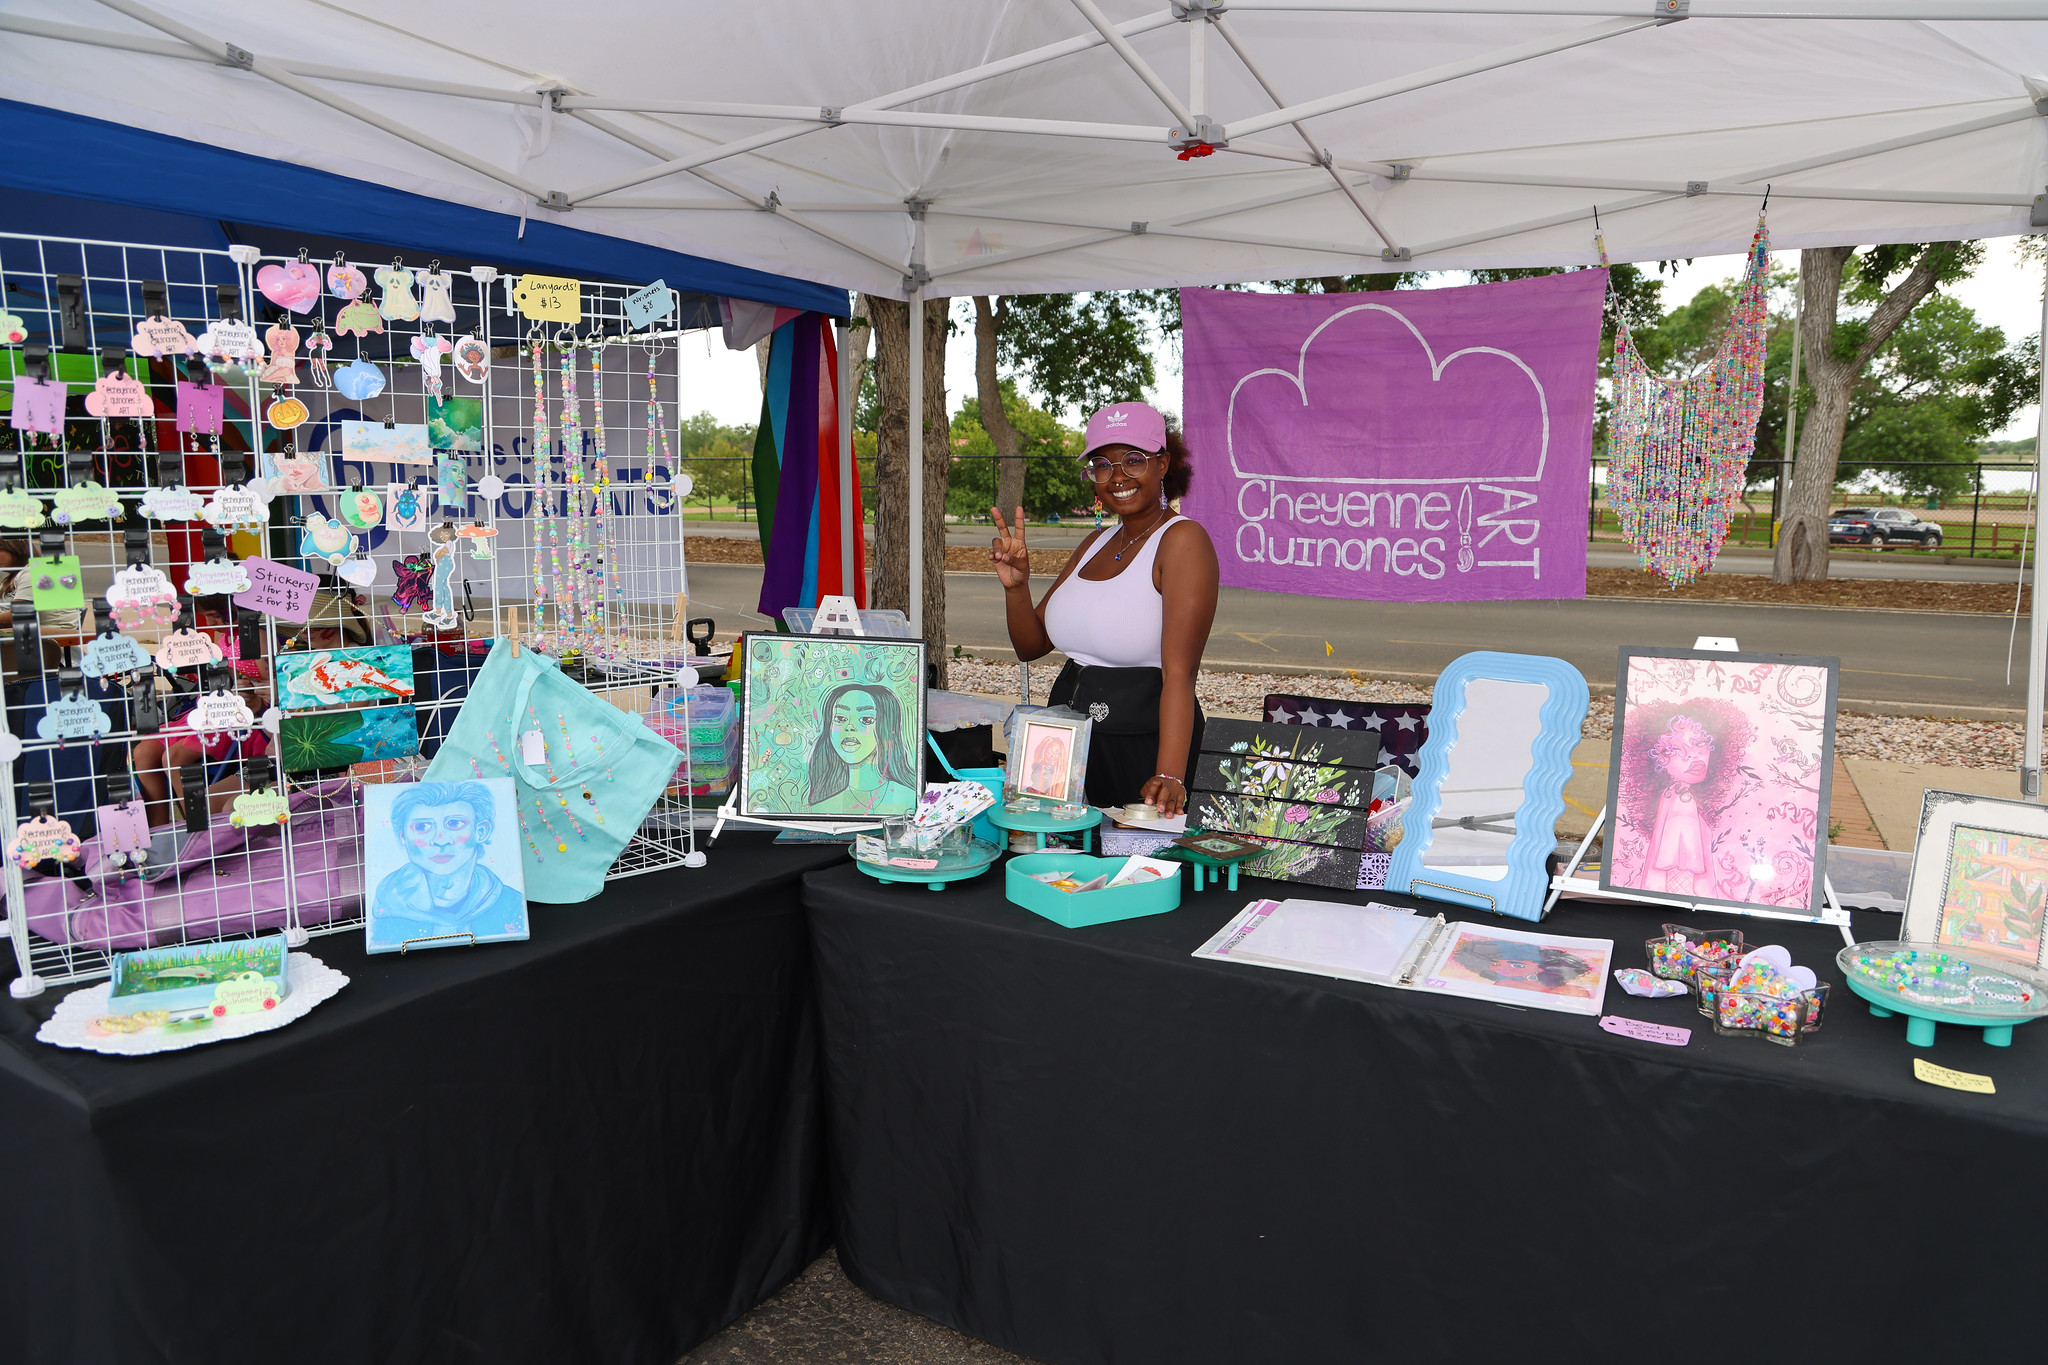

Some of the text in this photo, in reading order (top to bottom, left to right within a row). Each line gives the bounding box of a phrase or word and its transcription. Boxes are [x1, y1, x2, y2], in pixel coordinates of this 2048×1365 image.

[530, 280, 577, 294] Lanyards!
[540, 297, 562, 310] $13
[1237, 478, 1452, 532] Cheyenne
[1476, 483, 1541, 580] ART
[1235, 521, 1447, 580] Quinones
[255, 568, 314, 593] Stickers!
[267, 585, 282, 594] for
[286, 589, 299, 600] $3
[267, 597, 282, 606] for
[286, 601, 300, 611] $5
